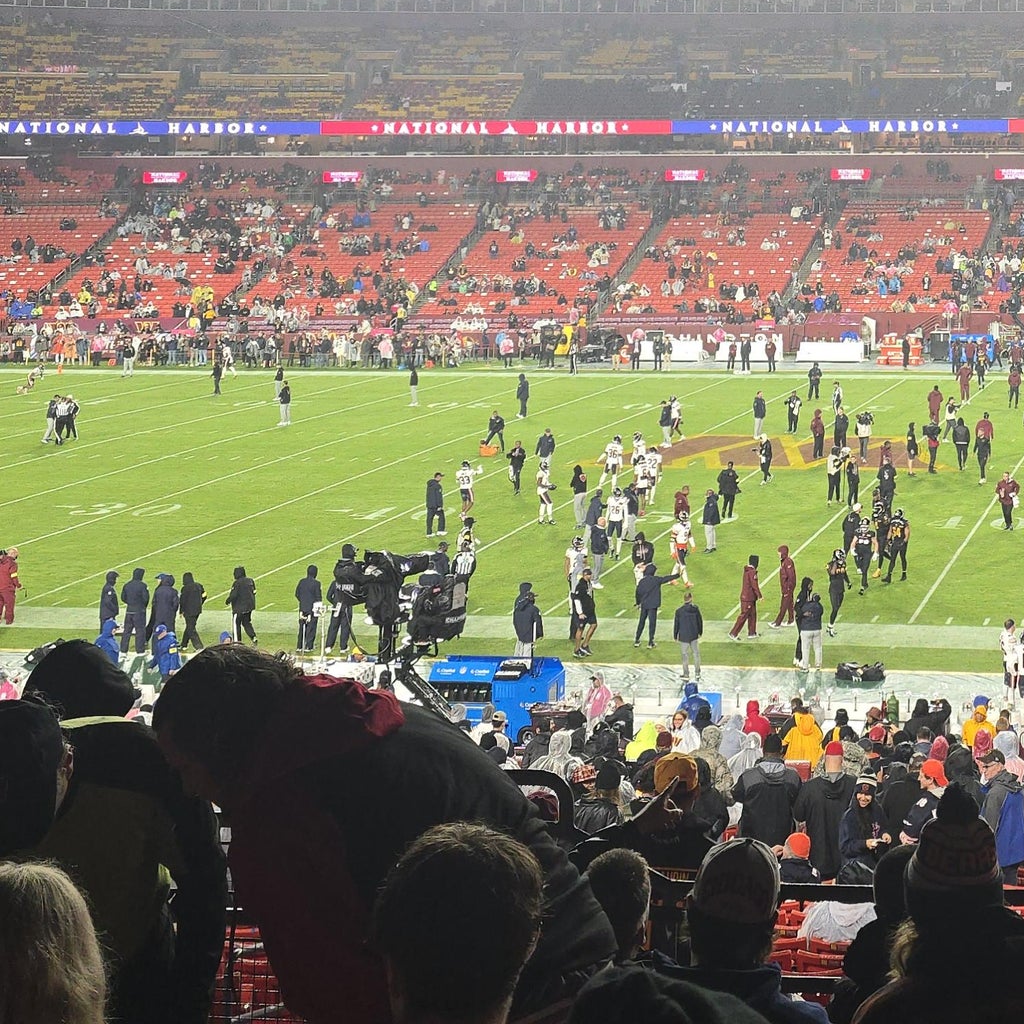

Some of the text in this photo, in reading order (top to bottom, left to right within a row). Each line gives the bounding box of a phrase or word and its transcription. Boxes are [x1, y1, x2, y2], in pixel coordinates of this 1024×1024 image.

[0, 123, 254, 134] NATIONAL HARBOR
[384, 122, 616, 134] NATIONAL HARBOR
[723, 121, 947, 133] NATIONAL HARBOR
[459, 476, 470, 485] 33
